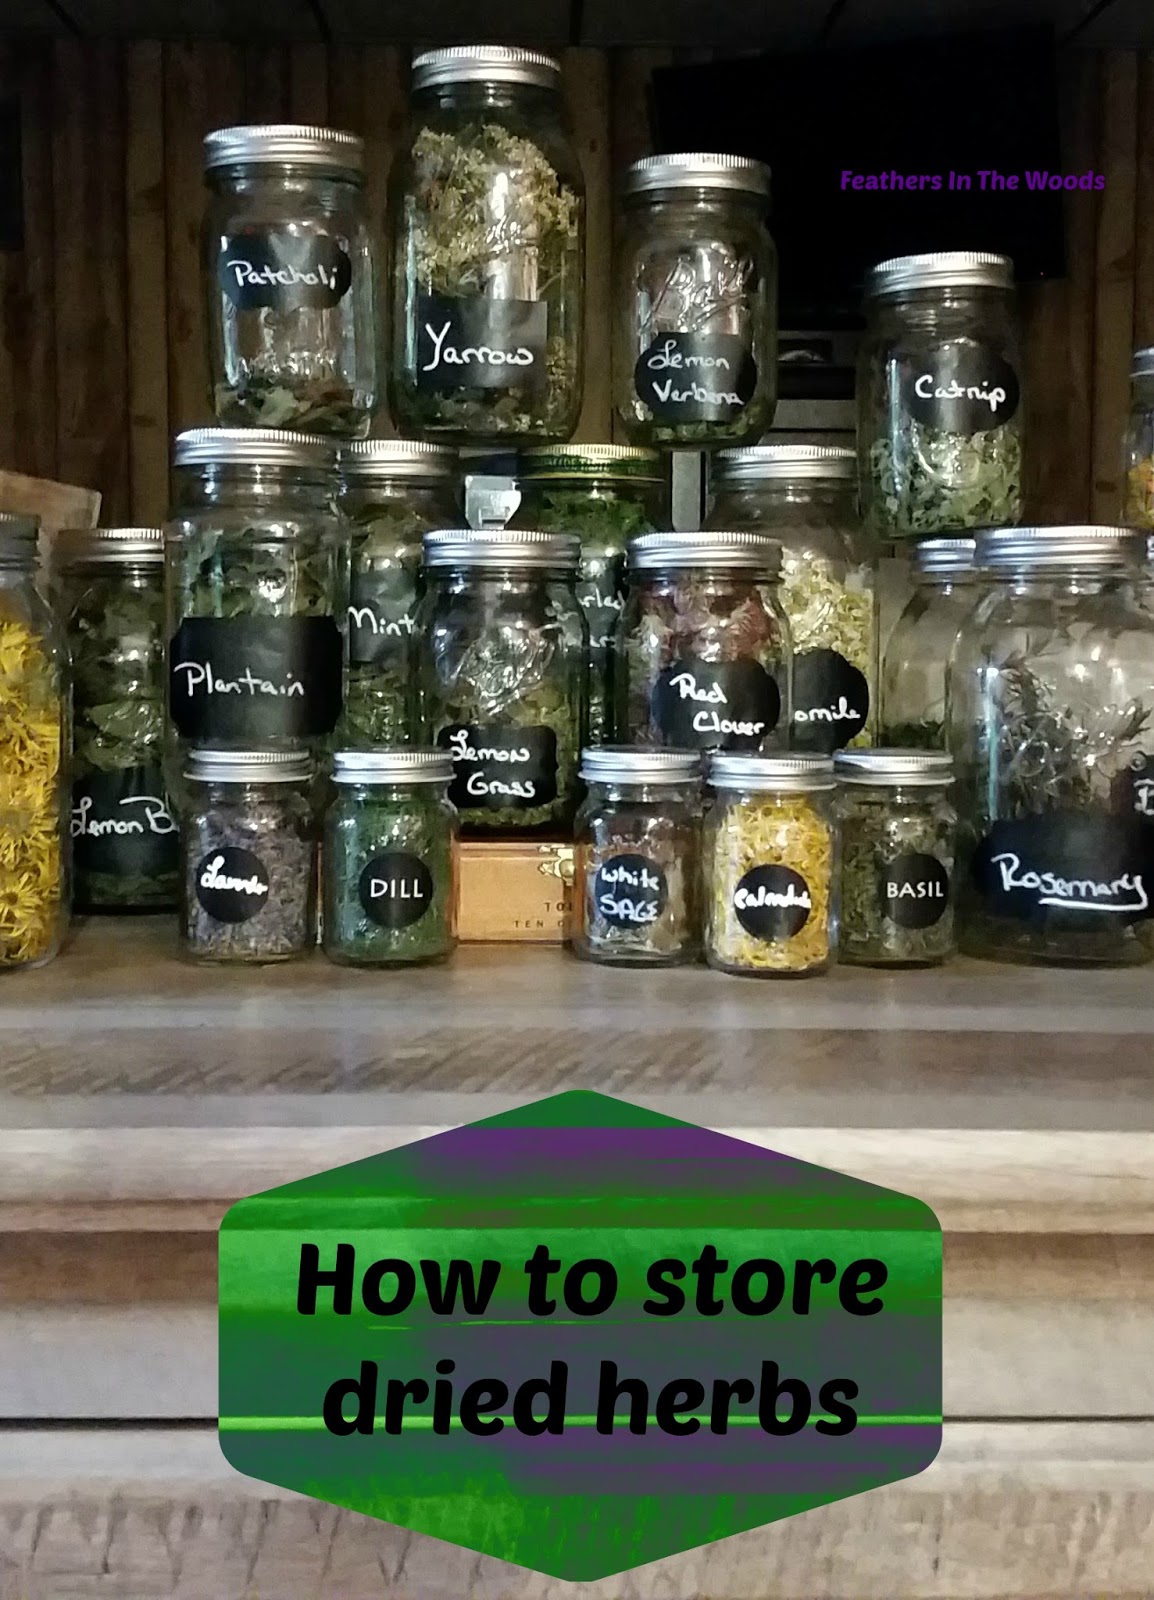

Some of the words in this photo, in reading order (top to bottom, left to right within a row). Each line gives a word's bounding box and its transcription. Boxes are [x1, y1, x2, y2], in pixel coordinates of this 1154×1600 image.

[422, 321, 534, 372] Yarrow
[647, 339, 730, 371] Lemon
[914, 373, 1006, 413] Catnip
[348, 606, 415, 636] Mint
[173, 662, 305, 697] Plantain
[669, 673, 728, 704] Red
[450, 729, 531, 763] Lemon
[467, 771, 536, 798] Grass
[70, 796, 144, 838] Lemon
[370, 878, 425, 899] DILL
[886, 881, 944, 899] BASIL
[991, 852, 1148, 911] Rosemary
[515, 920, 545, 929] TEN
